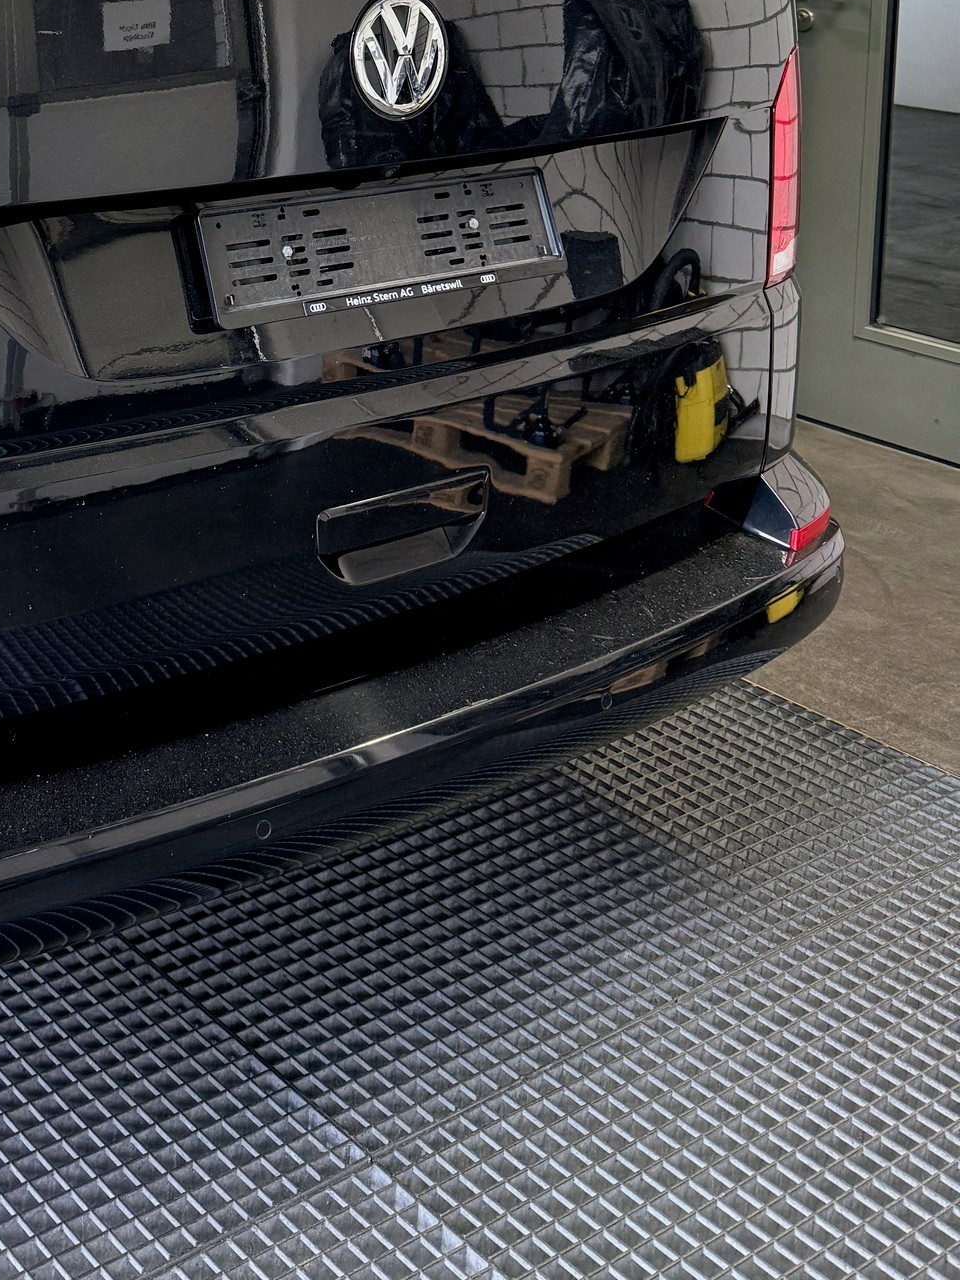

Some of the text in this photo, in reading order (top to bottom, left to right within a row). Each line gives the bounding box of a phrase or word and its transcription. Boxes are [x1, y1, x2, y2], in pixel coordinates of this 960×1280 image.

[346, 279, 463, 307] Heinz Stern AG Bäretswil
